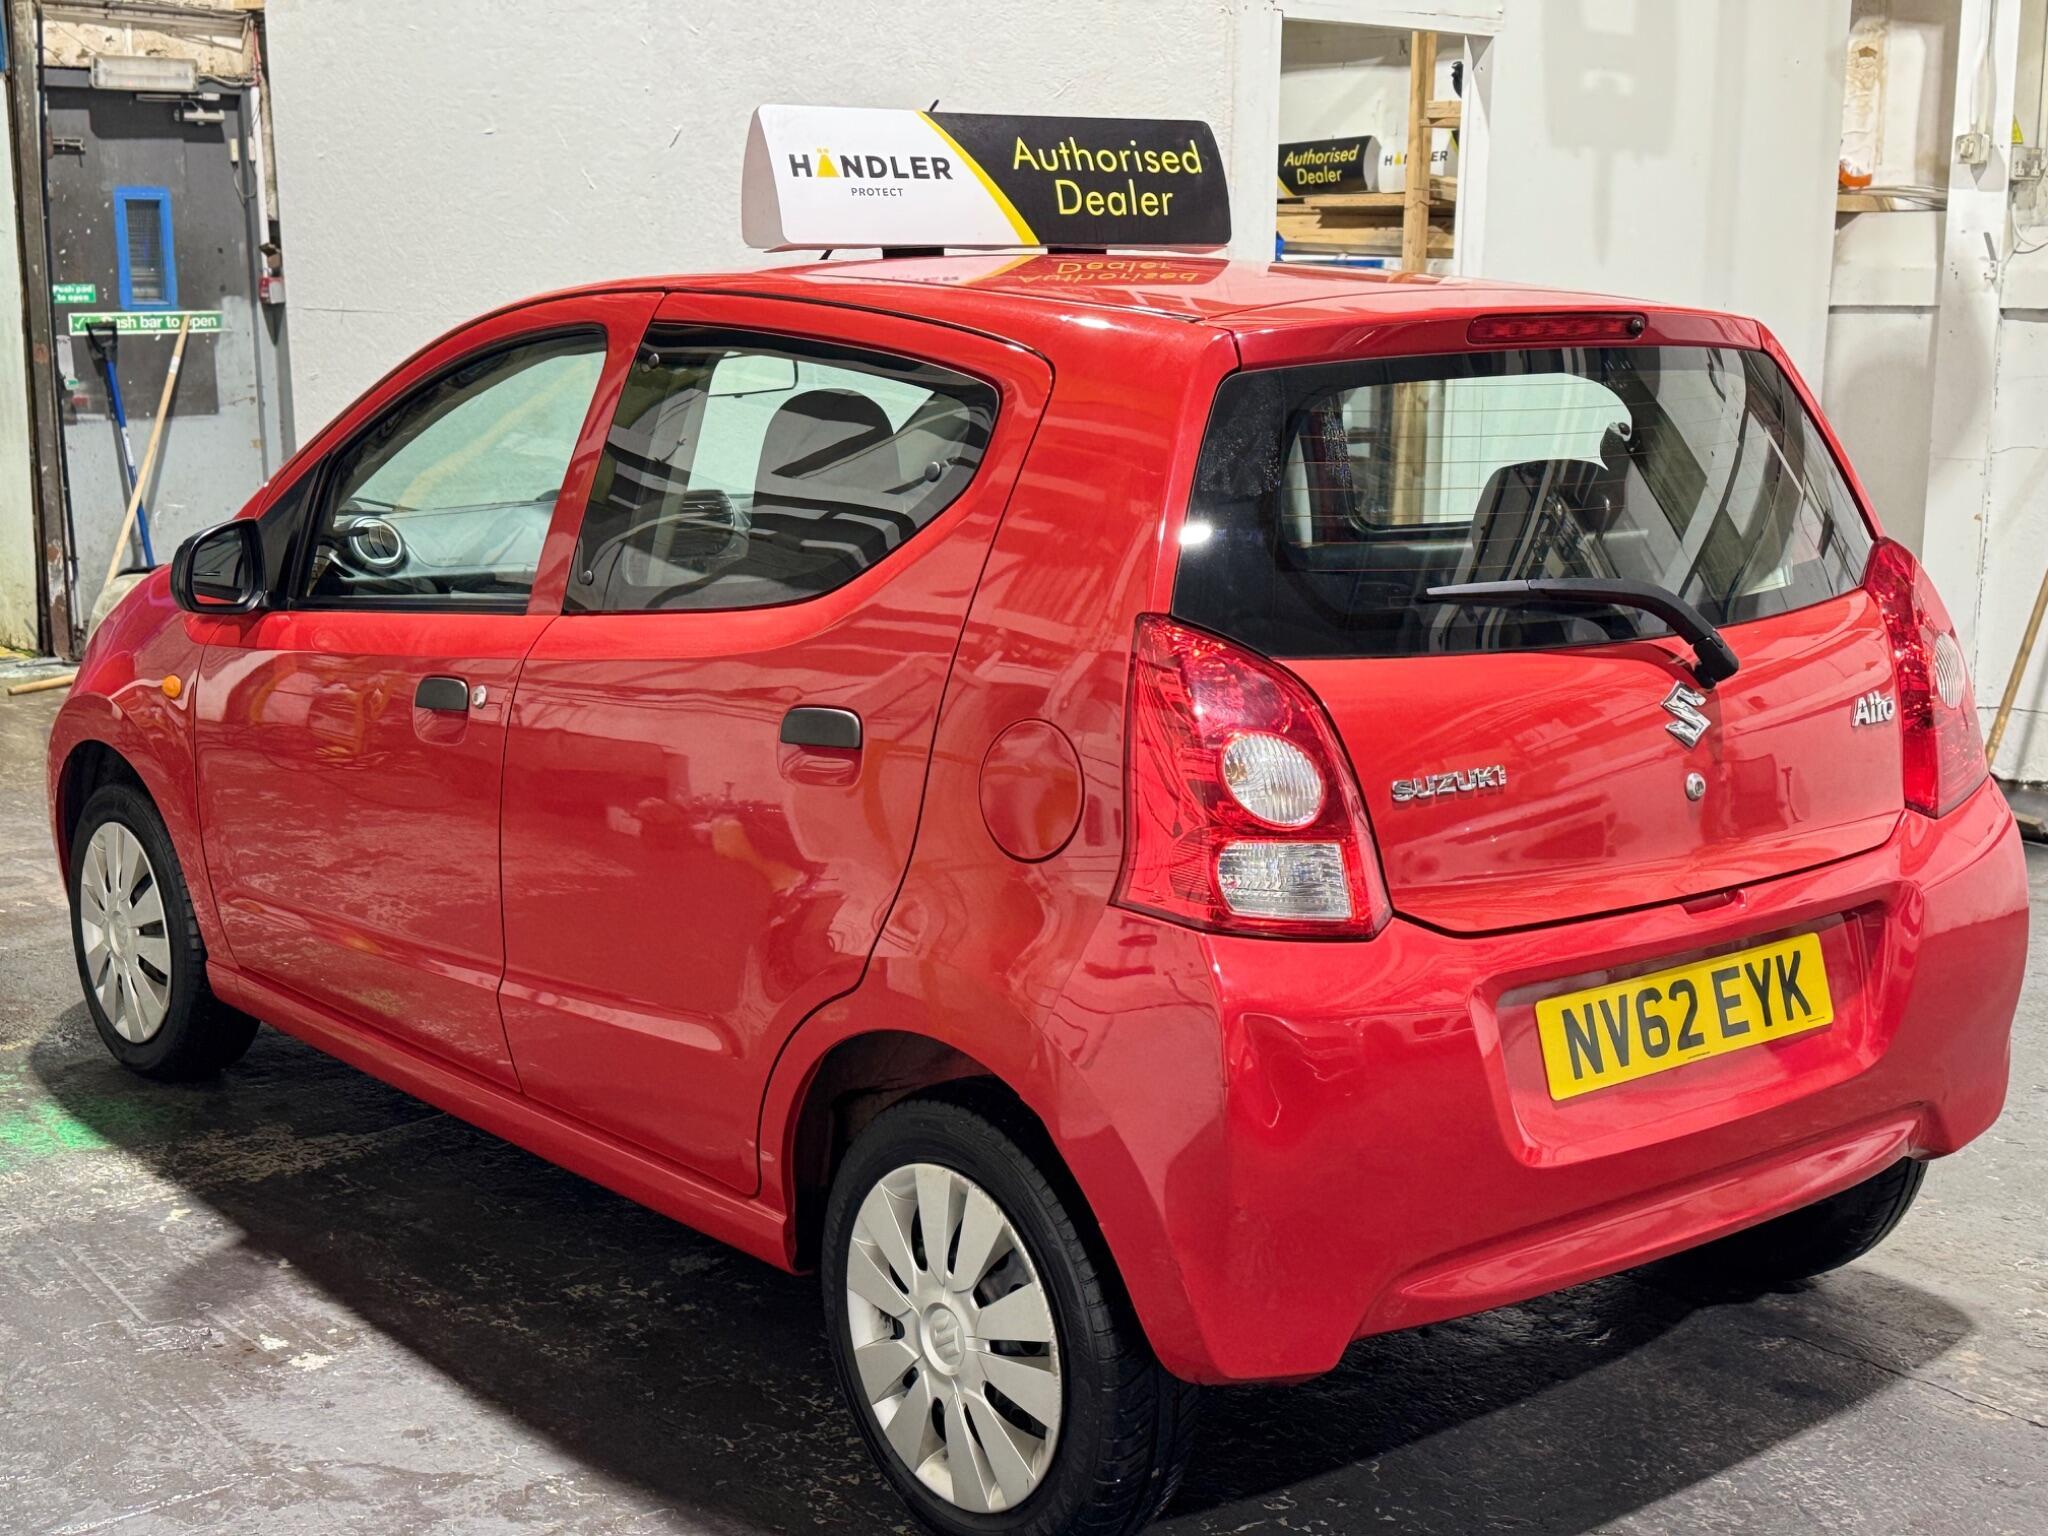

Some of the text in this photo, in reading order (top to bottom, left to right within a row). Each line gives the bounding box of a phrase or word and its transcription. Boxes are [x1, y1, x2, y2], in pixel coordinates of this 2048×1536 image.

[789, 148, 953, 180] HÄNDLER
[1013, 136, 1202, 174] Authorised
[1284, 144, 1360, 167] Authorised
[851, 187, 904, 197] PROTECT
[1296, 165, 1342, 185] Dealer
[1055, 178, 1173, 216] Dealer
[140, 315, 163, 328] bar
[165, 315, 180, 328] to
[187, 316, 217, 331] pen
[1851, 690, 1895, 727] Alto
[1391, 764, 1507, 802] SUZUKI
[1562, 950, 1812, 1080] NV62 EYK
